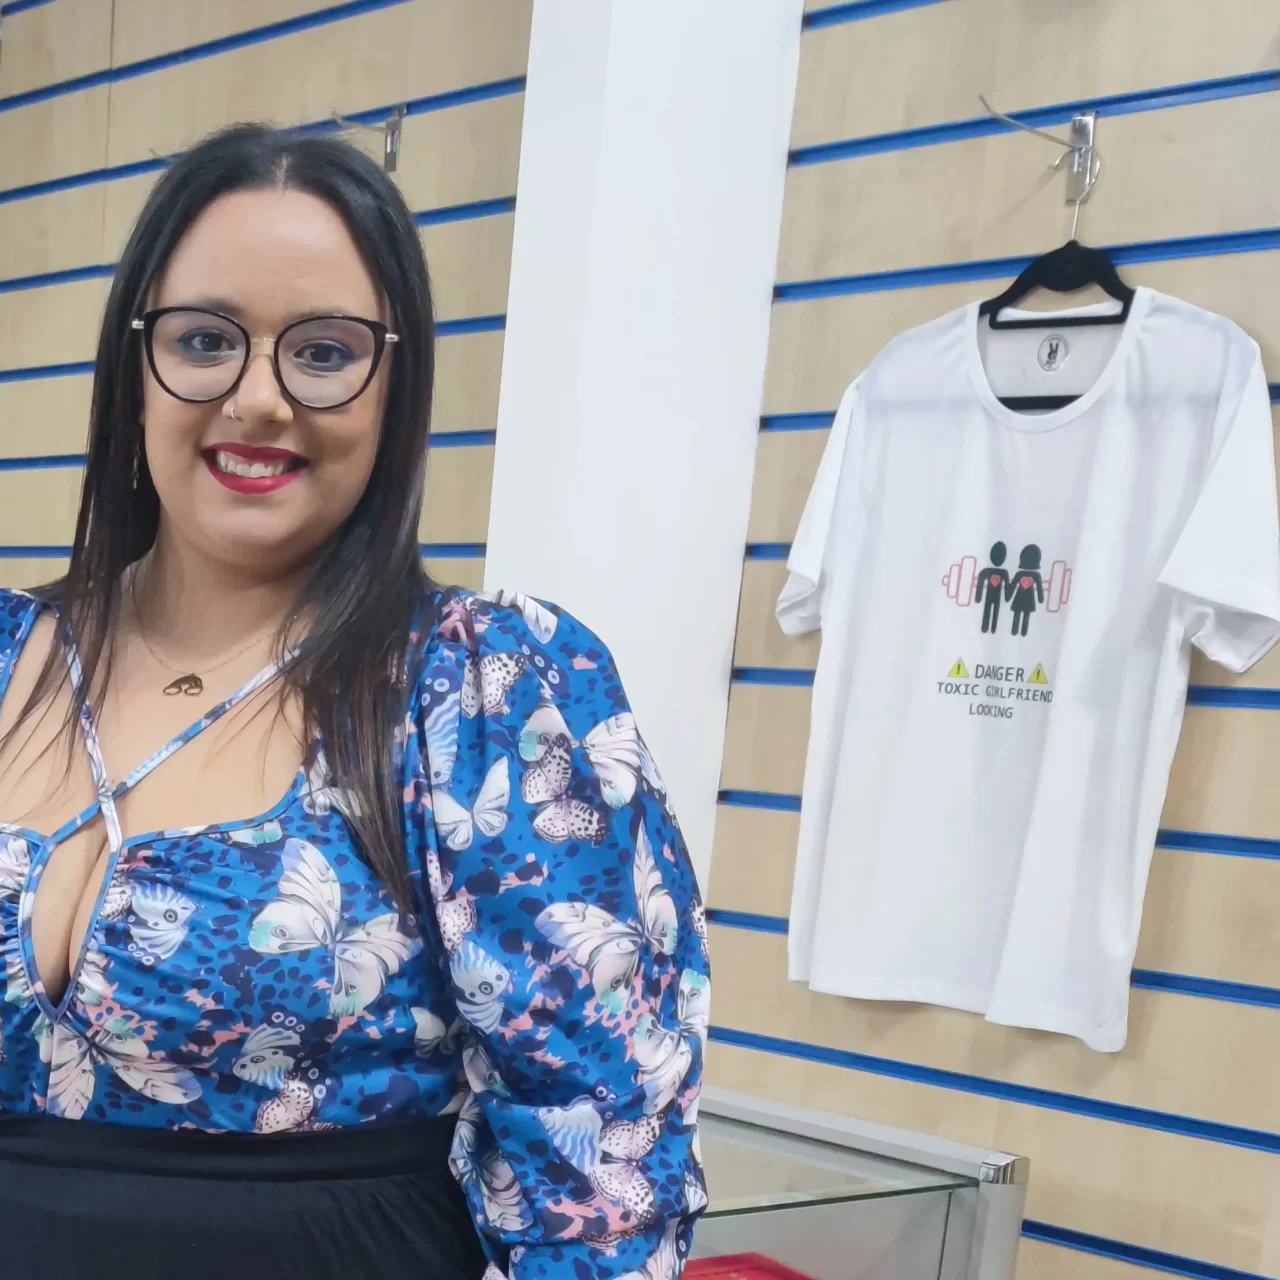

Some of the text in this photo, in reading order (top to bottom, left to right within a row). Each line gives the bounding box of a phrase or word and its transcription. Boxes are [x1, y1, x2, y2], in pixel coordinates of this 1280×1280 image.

[975, 664, 1025, 682] DANGER
[937, 681, 1054, 703] TOXIC GIRLFRIEND
[969, 703, 1012, 719] LOOKING
